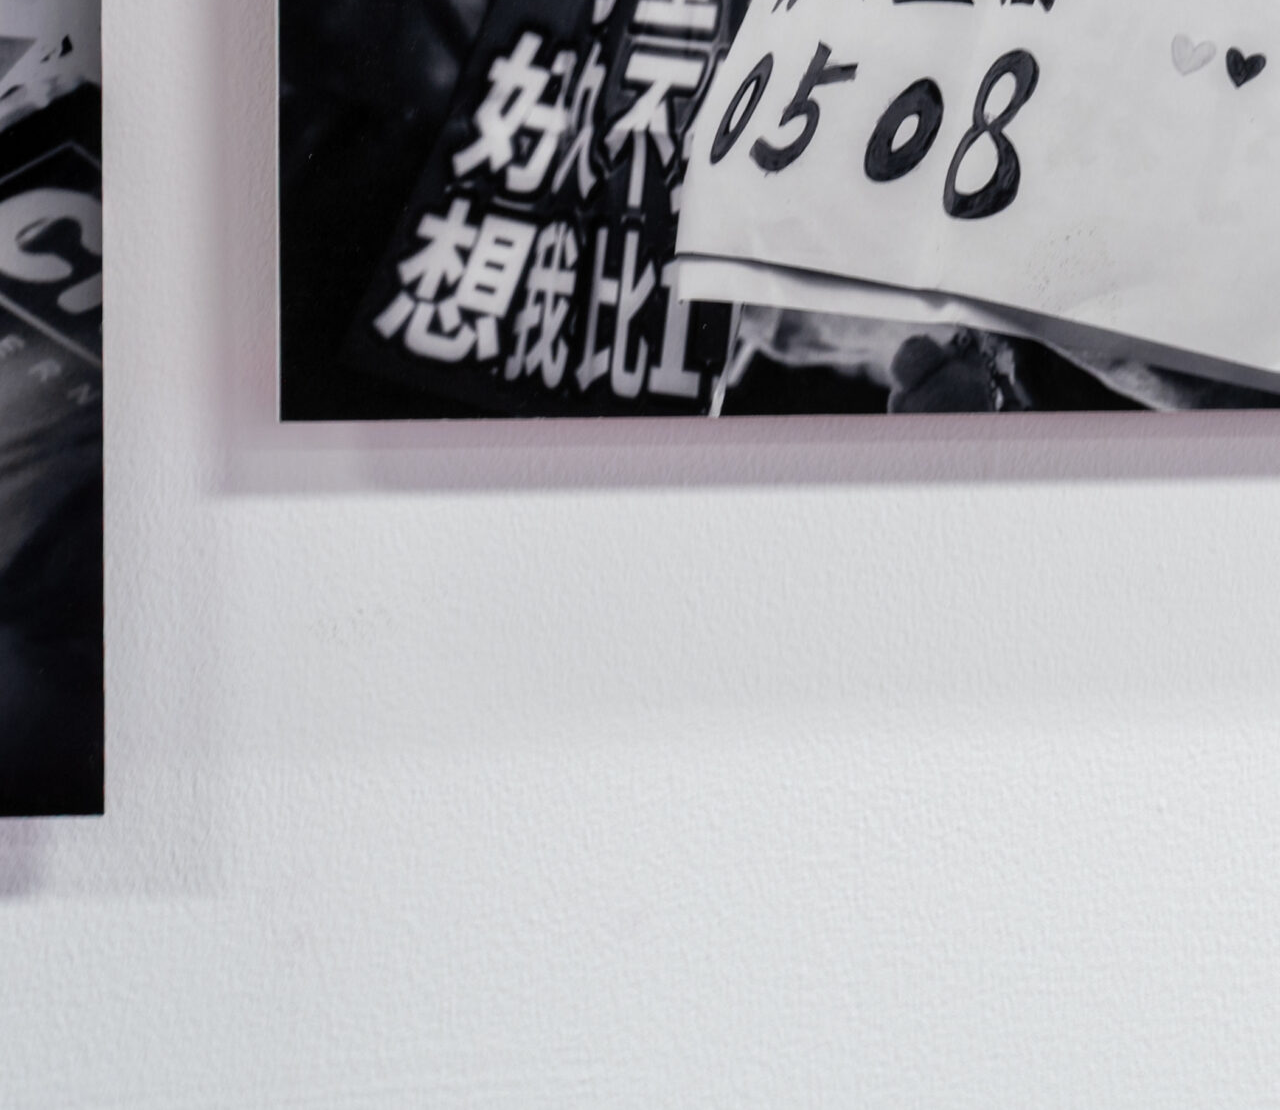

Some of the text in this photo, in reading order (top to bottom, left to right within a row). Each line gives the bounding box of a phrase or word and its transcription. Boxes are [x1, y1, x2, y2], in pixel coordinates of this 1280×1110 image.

[453, 30, 704, 214] 好久不
[709, 41, 1040, 220] 0508
